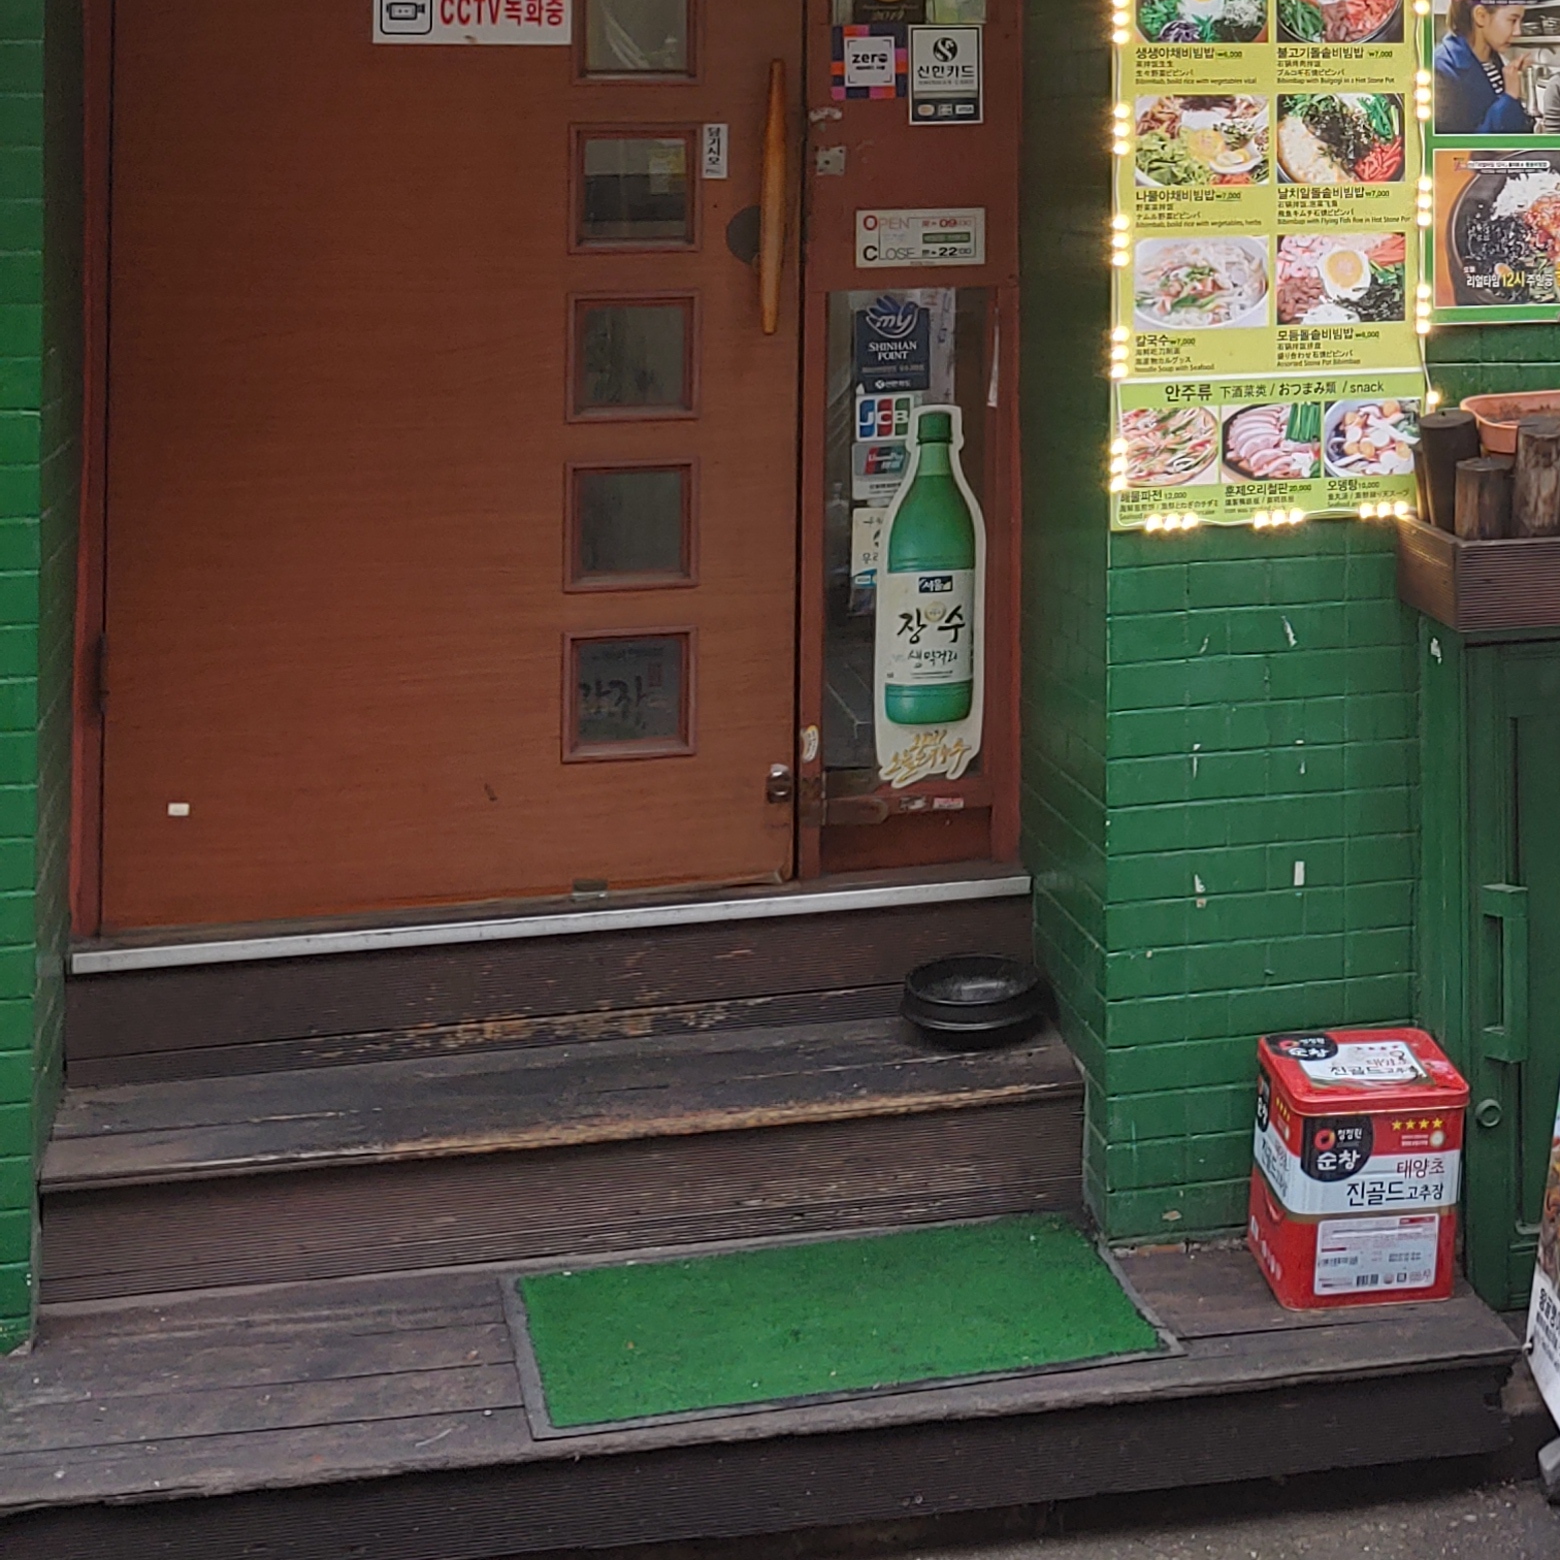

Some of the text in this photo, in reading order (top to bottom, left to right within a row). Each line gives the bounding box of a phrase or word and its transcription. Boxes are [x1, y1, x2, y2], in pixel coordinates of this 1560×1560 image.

[852, 53, 888, 64] zero
[1136, 47, 1215, 60] 생생야채비빔밥
[1277, 47, 1364, 59] 불고기돌솥비빔밥
[917, 64, 975, 79] 신한카드
[1136, 190, 1215, 202] 나물야채비빔밥
[863, 215, 910, 231] OPEN
[863, 245, 915, 261] CLOSE
[1135, 335, 1169, 348] 칼국수
[1277, 328, 1354, 342] 모듬돌솥비빔밥
[868, 341, 917, 351] SHINHAN
[877, 350, 908, 360] POINT
[1165, 384, 1213, 403] 안주류
[1278, 381, 1337, 396] おつまみ類
[1350, 381, 1384, 393] snack
[860, 410, 908, 425] JCB
[1225, 483, 1288, 498] 훈제오리철판
[1289, 1045, 1330, 1058] 순창
[1337, 1128, 1363, 1141] 청정원
[1316, 1149, 1362, 1172] 순창
[1396, 1157, 1446, 1180] 태양초
